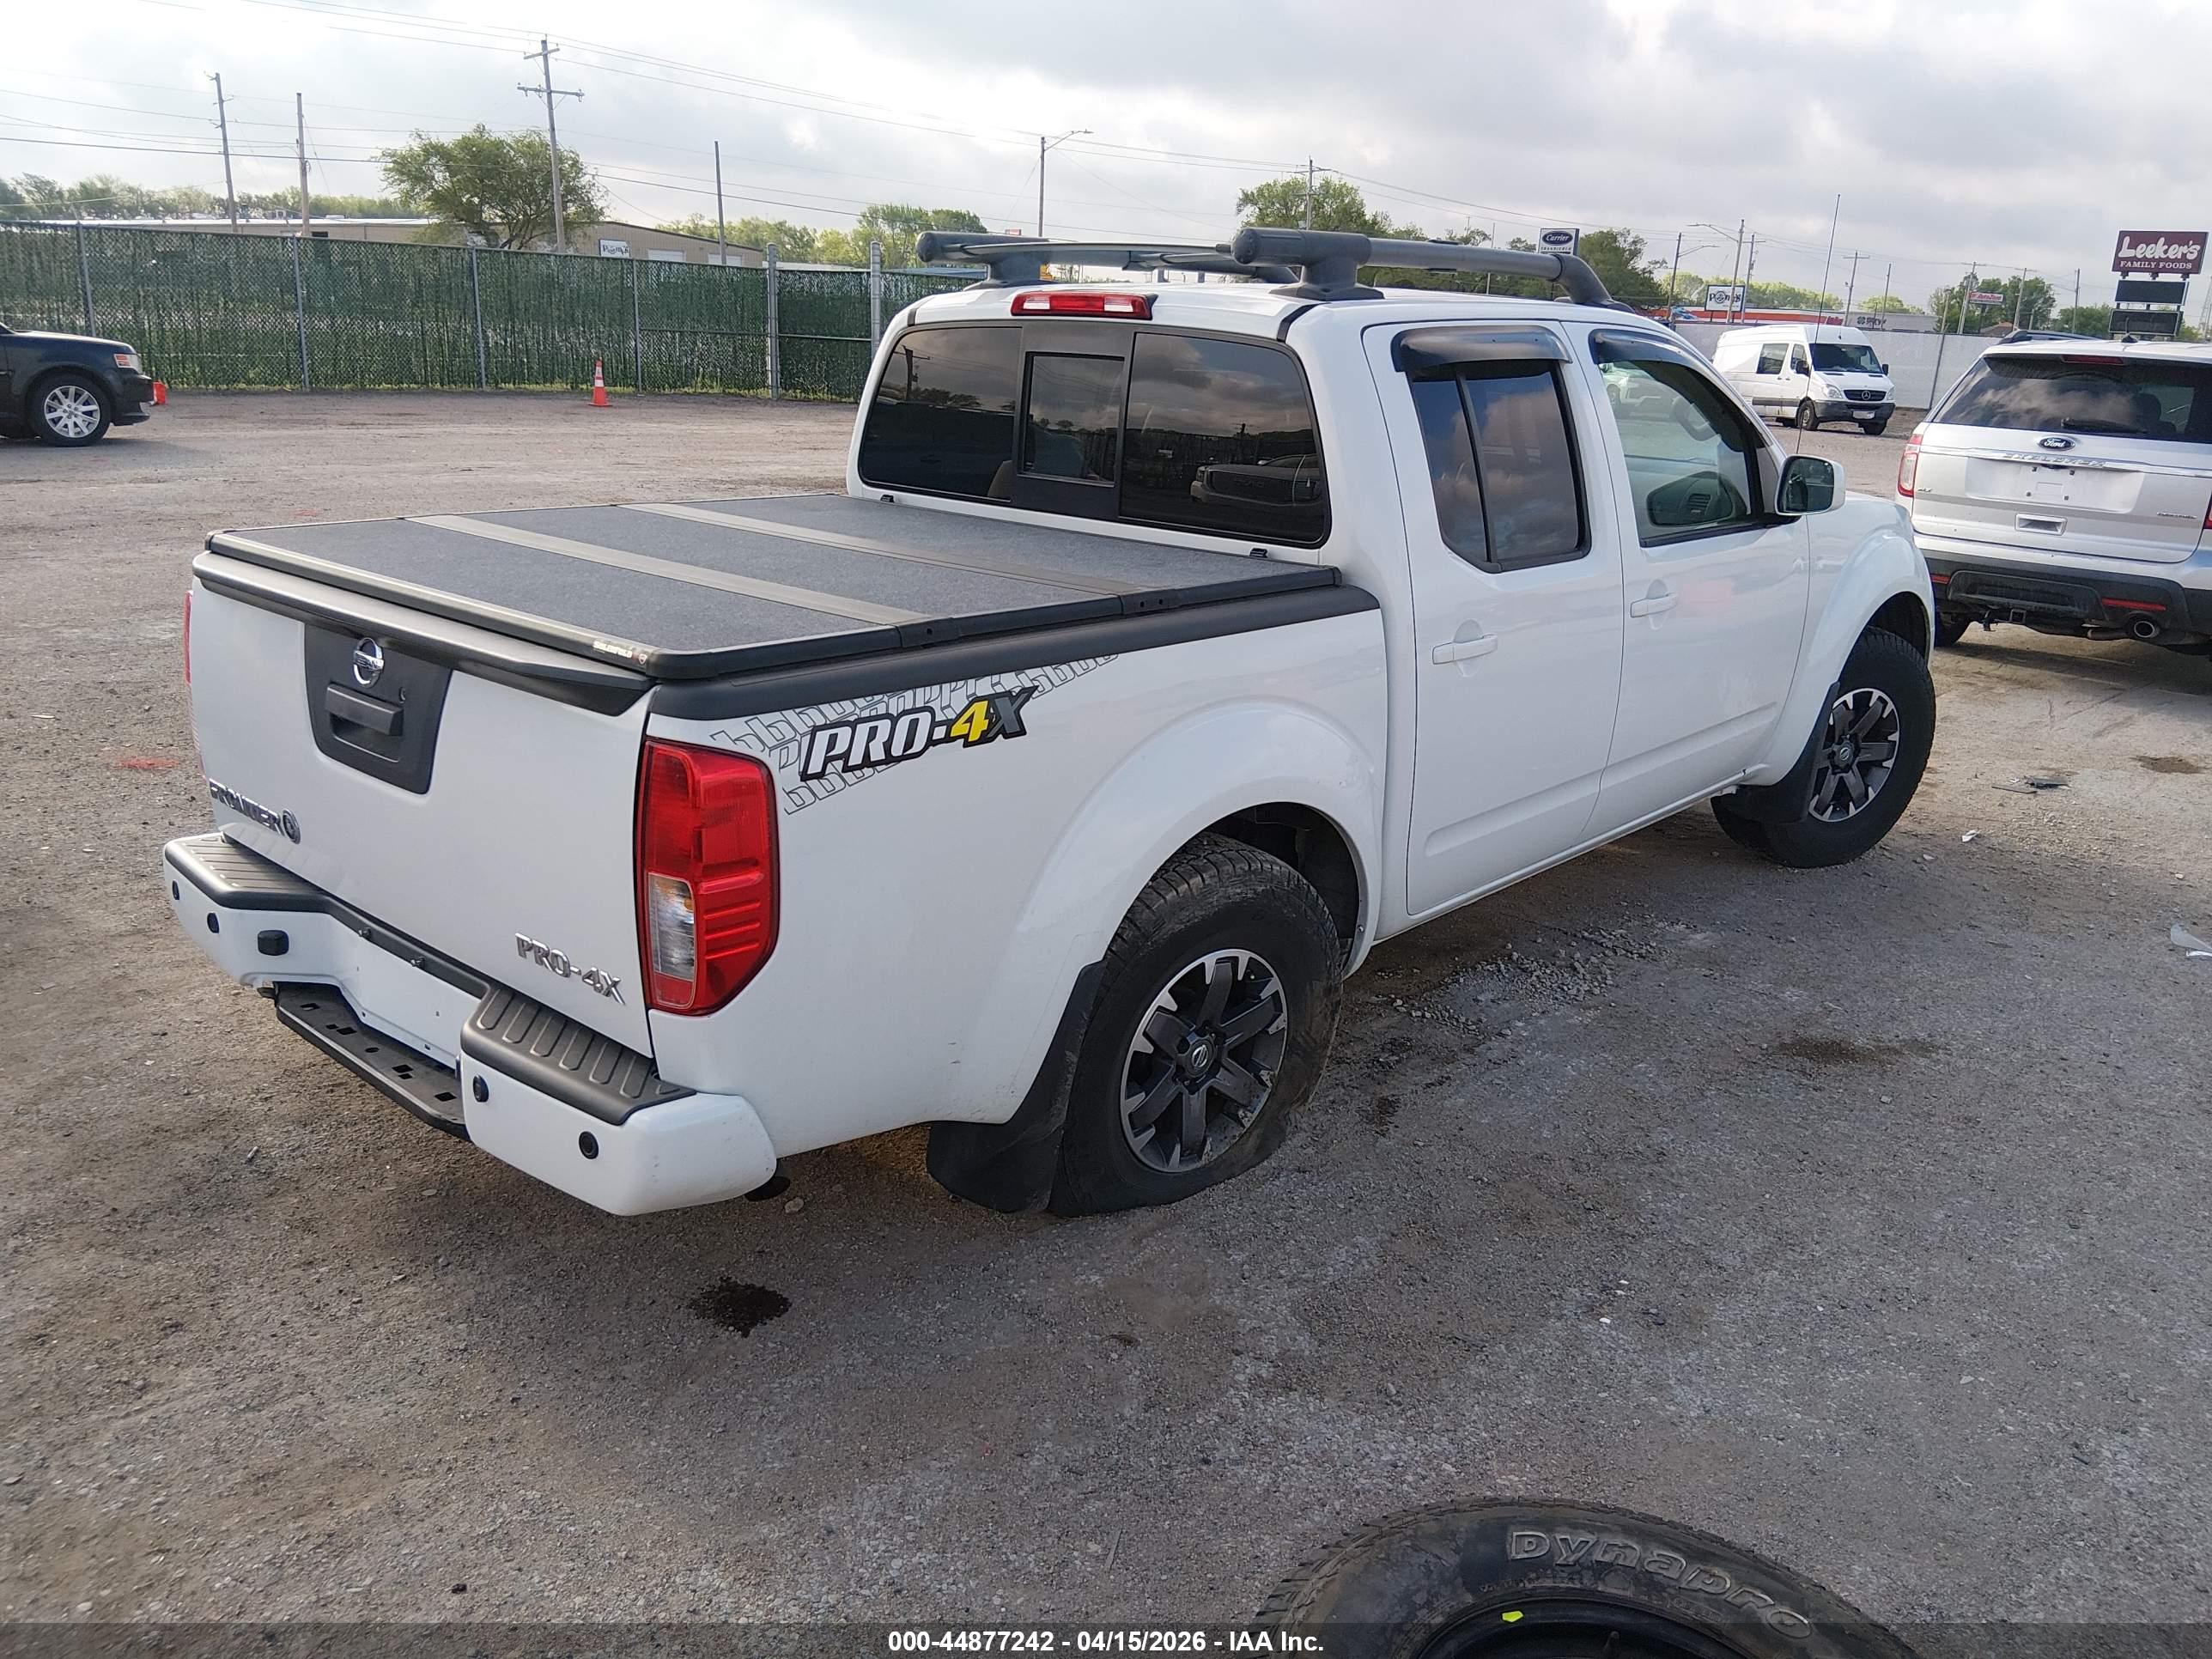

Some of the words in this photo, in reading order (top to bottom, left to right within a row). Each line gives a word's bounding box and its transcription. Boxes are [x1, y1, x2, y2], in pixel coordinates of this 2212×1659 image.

[2118, 236, 2201, 260] Leeker's
[2044, 438, 2066, 447] Ford
[802, 687, 1036, 781] PRO-4X
[515, 933, 626, 1005] PRO-4X
[1509, 1531, 1814, 1639] Dynapro
